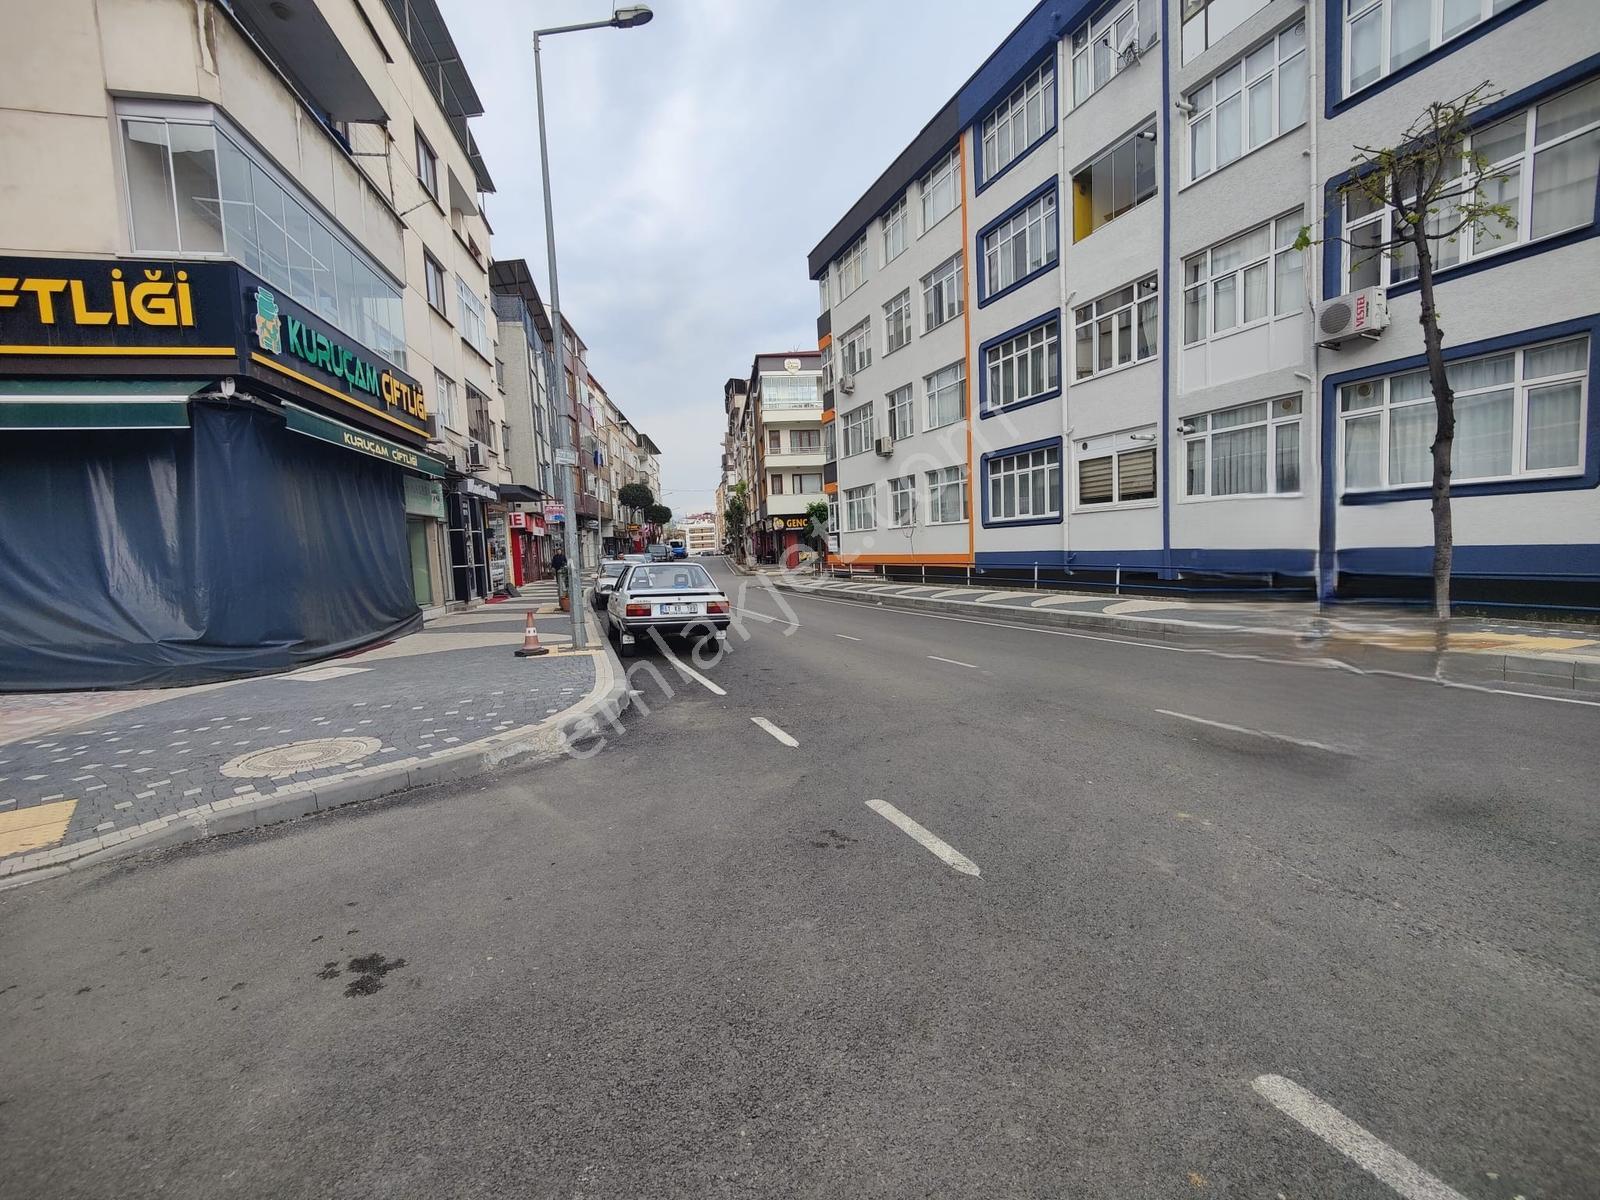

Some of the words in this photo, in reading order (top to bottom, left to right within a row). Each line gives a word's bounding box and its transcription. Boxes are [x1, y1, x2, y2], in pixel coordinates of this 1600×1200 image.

[1356, 294, 1366, 327] VESTEL
[287, 315, 380, 397] KURUÇAM
[343, 432, 389, 457] KURUÇAM
